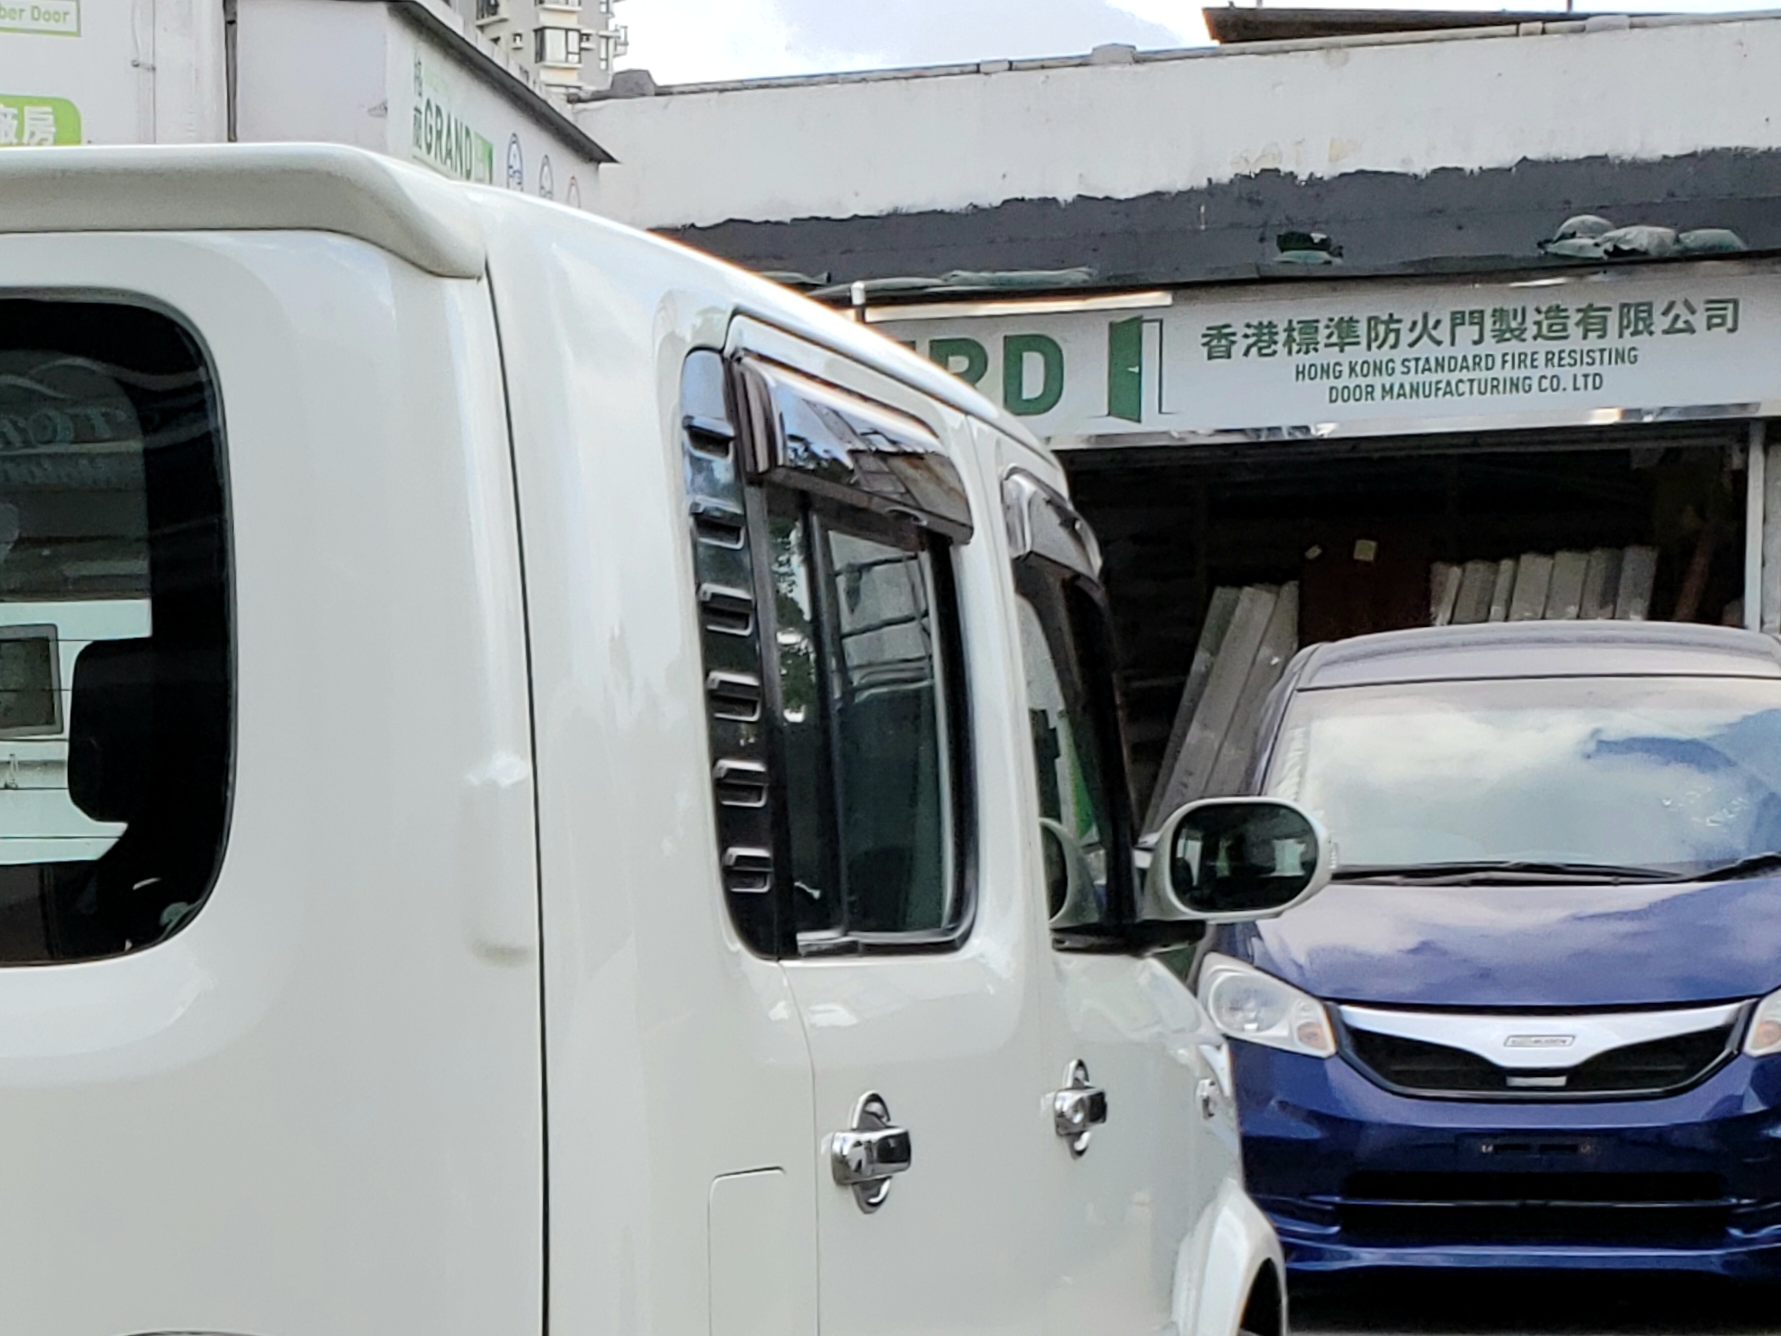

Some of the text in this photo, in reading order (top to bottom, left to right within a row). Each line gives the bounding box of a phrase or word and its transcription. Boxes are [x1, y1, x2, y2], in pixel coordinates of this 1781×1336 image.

[30, 5, 70, 24] Door
[424, 97, 473, 181] GRAND
[1200, 297, 1740, 361] 香港標準防火門製造有限公司
[1295, 346, 1639, 382] HONG KONG STANDARD FIRE RESISTING
[1328, 372, 1604, 404] DOOR MANUFACTURING CO. LTD
